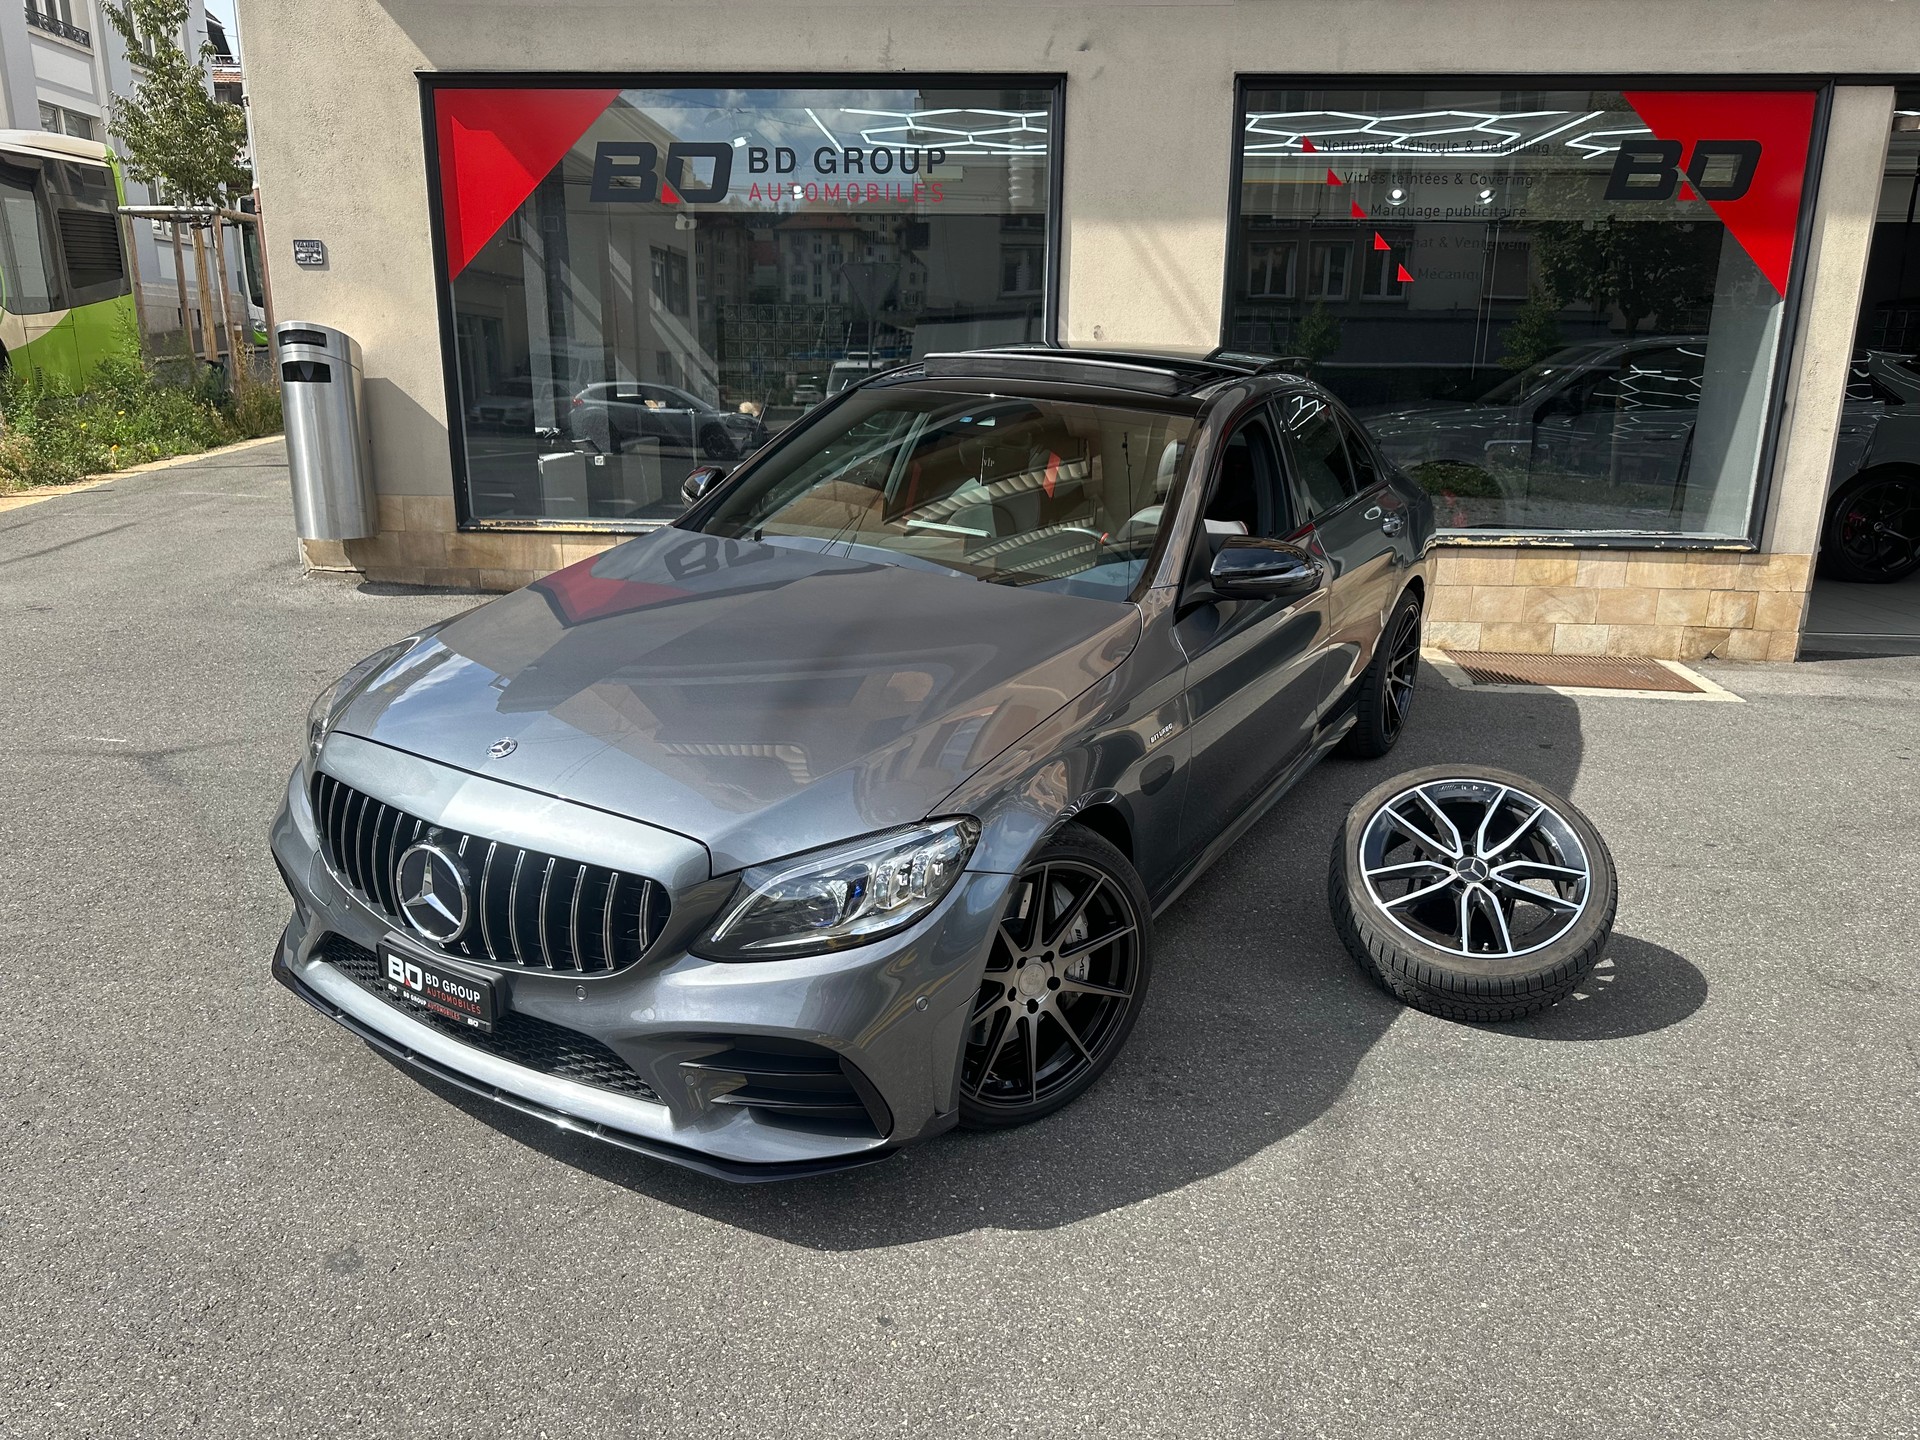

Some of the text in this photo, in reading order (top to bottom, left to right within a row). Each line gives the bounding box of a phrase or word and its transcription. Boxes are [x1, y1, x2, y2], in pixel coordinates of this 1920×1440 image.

[748, 146, 947, 175] BD GROUP
[1321, 139, 1394, 155] Nettoyage
[1400, 139, 1458, 153] véhicule
[1464, 140, 1474, 152] &
[589, 141, 734, 203] BD
[1344, 171, 1533, 188] Vitres teintées & Covering
[1603, 139, 1763, 201] BD
[748, 182, 945, 203] AUTOMOBILES
[1370, 204, 1527, 220] Marquage publicitaire
[425, 972, 481, 1003] BD GROUP
[426, 987, 482, 1015] AUTOMOBILES
